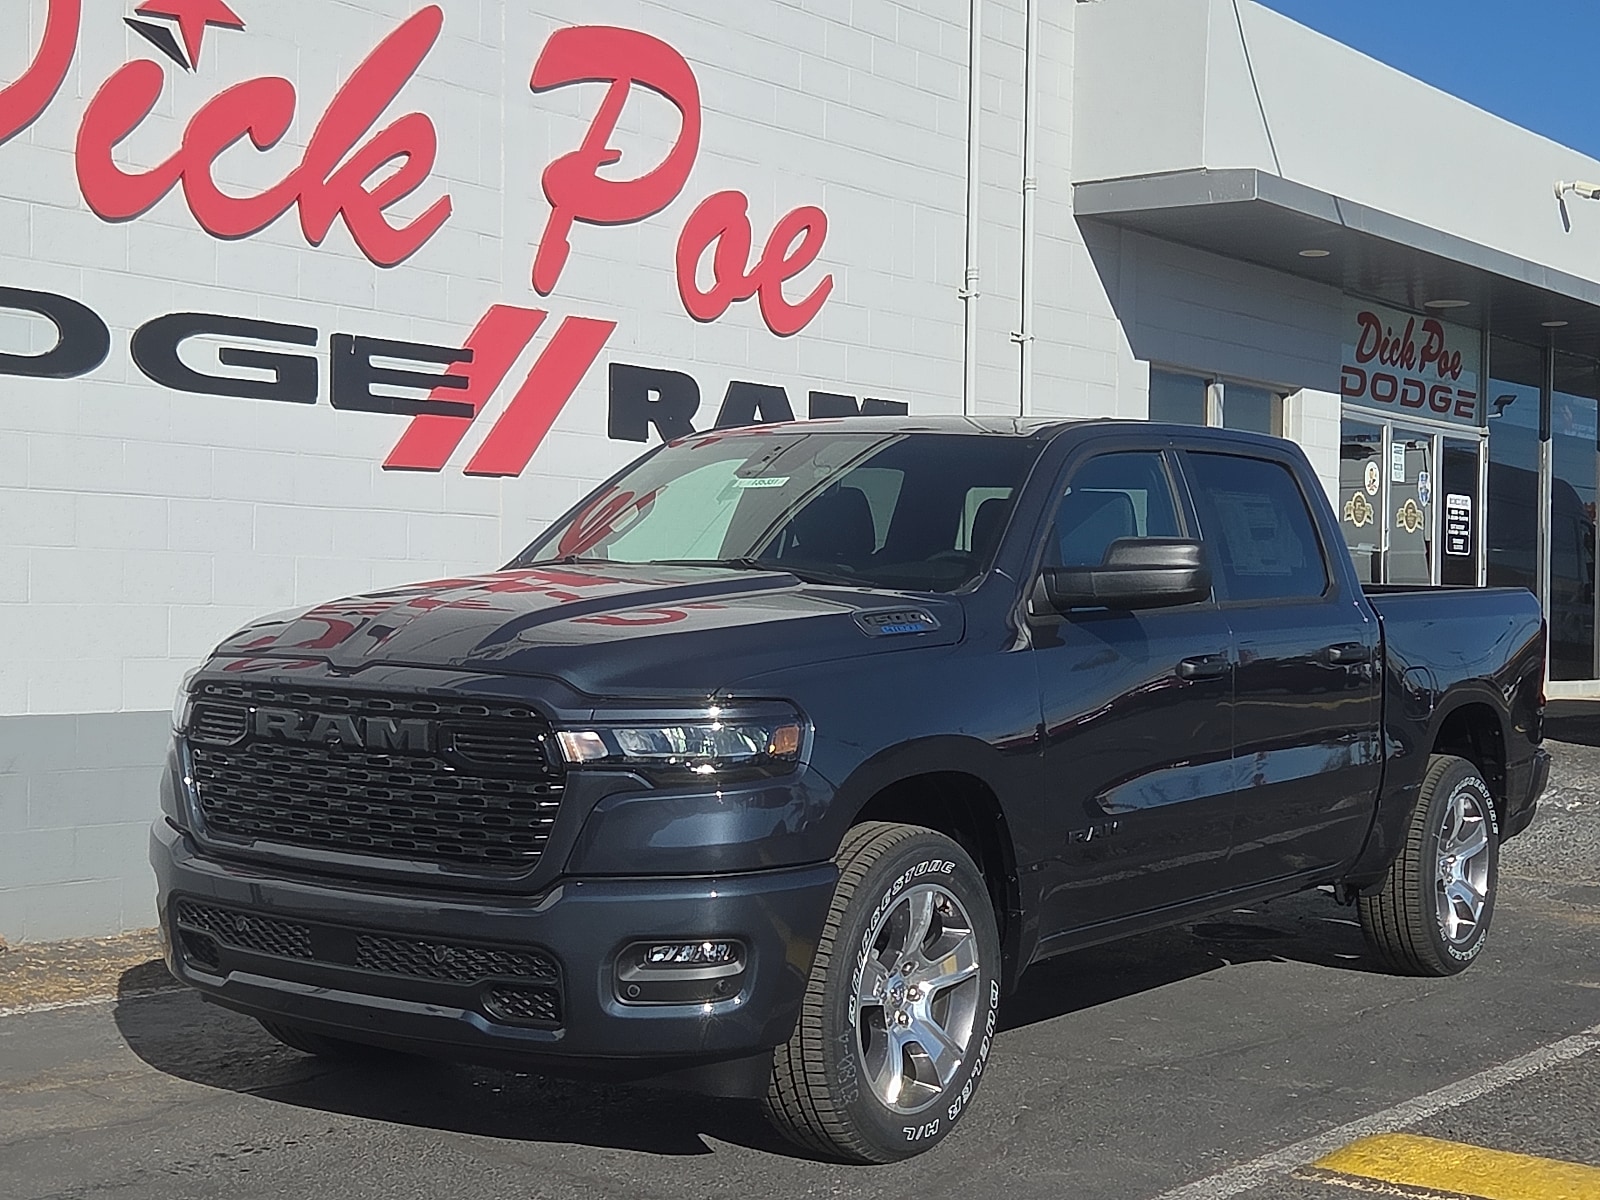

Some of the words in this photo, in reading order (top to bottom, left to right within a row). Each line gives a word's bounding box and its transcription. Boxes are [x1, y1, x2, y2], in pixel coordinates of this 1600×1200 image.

[530, 25, 833, 337] Poe
[1356, 311, 1416, 371] Dick
[1419, 319, 1463, 381] Poe
[1341, 365, 1477, 419] DODGE
[255, 707, 431, 752] RAM
